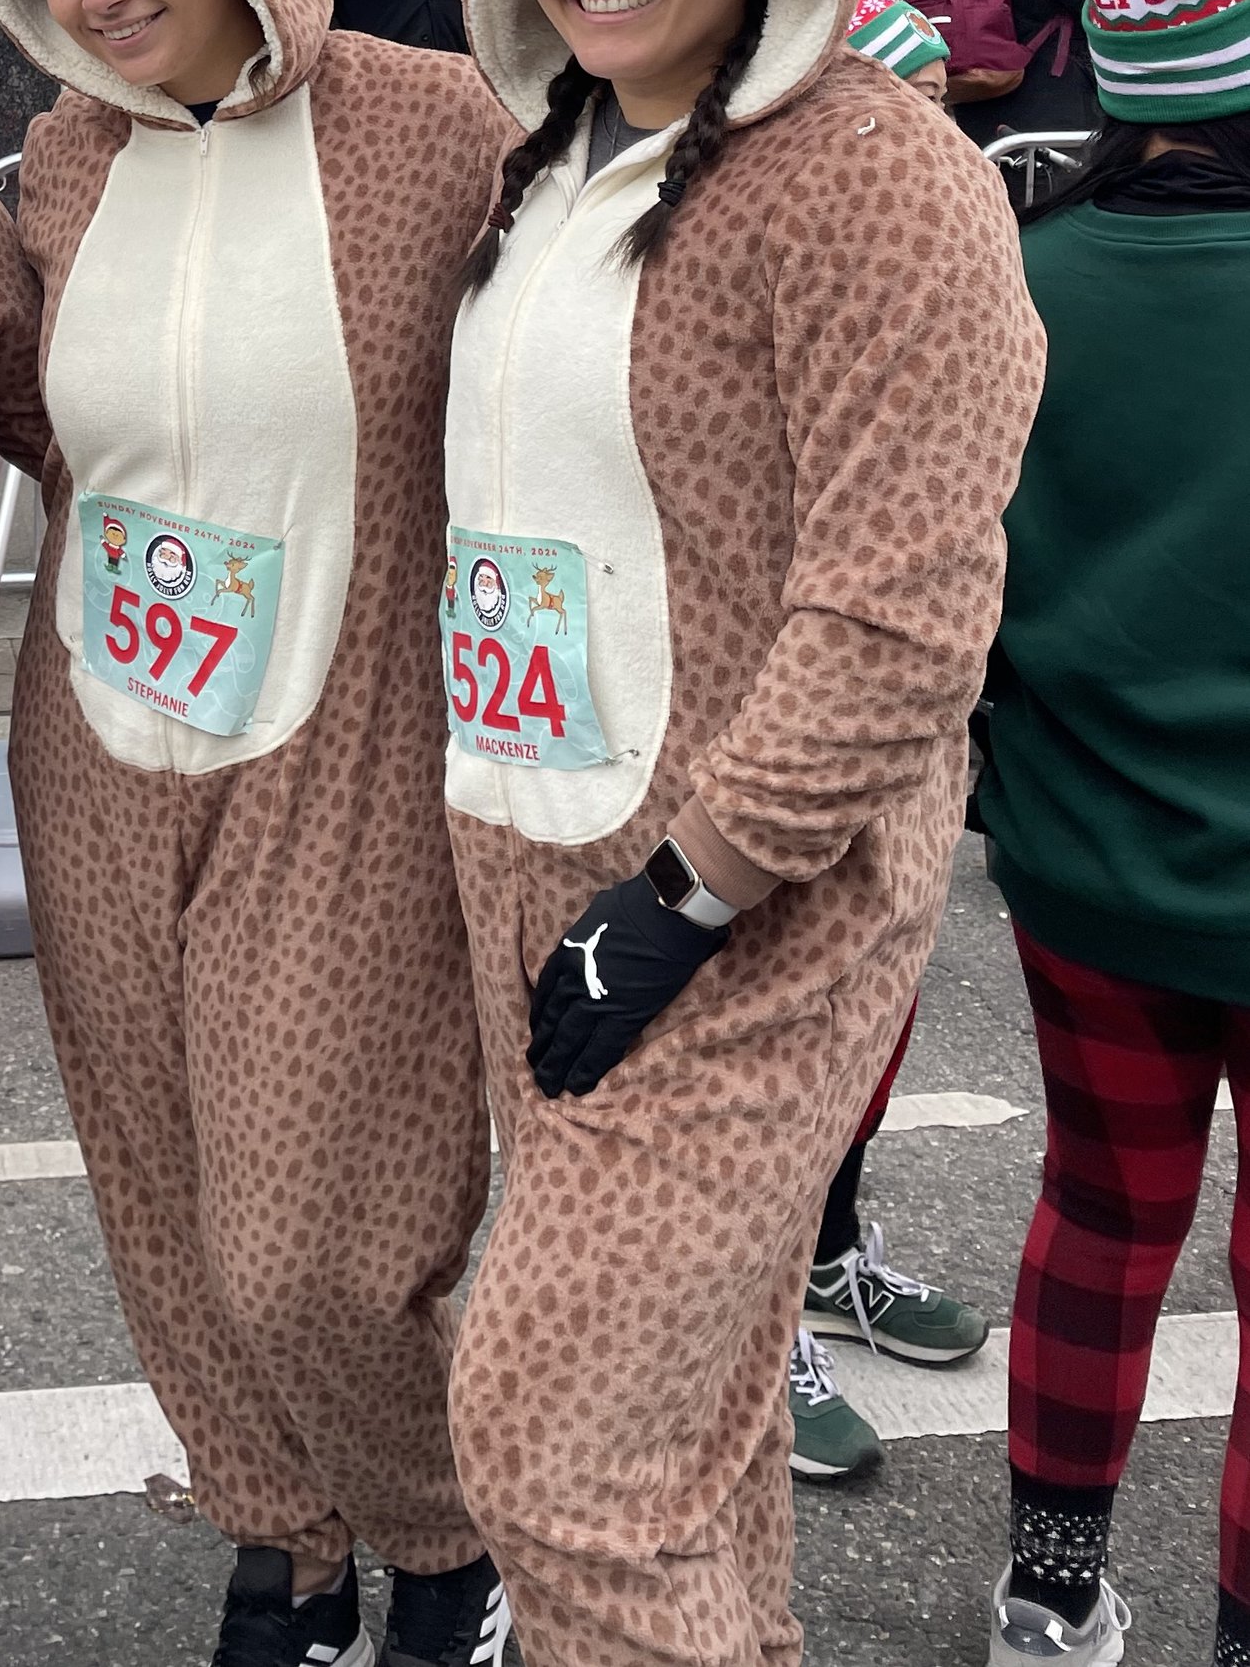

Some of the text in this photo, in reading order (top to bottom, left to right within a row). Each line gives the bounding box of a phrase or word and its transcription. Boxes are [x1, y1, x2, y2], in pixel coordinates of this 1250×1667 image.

[97, 501, 136, 517] SUNDAY
[139, 511, 191, 534] NOVEMBER
[228, 538, 256, 551] 2024
[531, 547, 558, 556] 2024
[105, 585, 238, 698] 597
[126, 677, 189, 718] STEPHANIE
[451, 631, 566, 738] 524
[475, 734, 541, 761] MACKENZE
